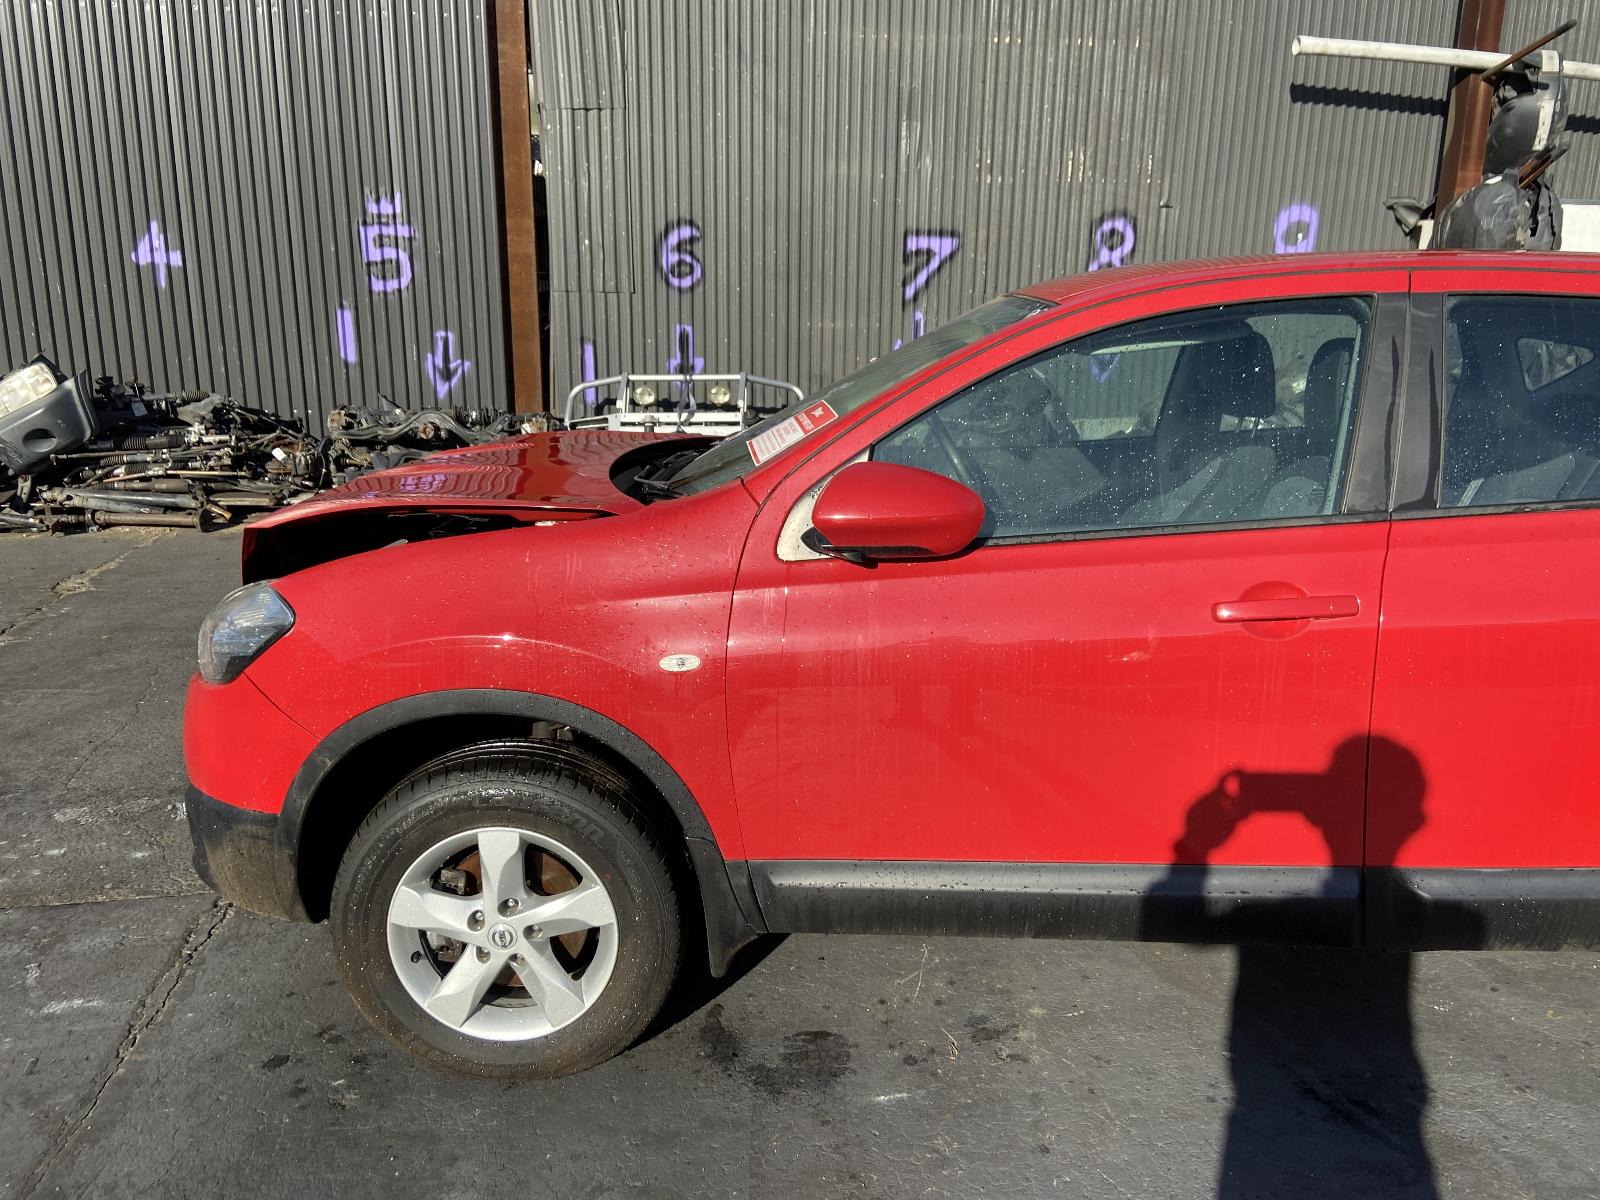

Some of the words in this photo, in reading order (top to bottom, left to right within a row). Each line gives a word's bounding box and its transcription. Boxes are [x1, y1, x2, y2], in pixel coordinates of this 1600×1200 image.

[131, 219, 183, 288] 4
[359, 223, 418, 293] 5
[660, 221, 703, 290] 6
[903, 232, 961, 301] 7
